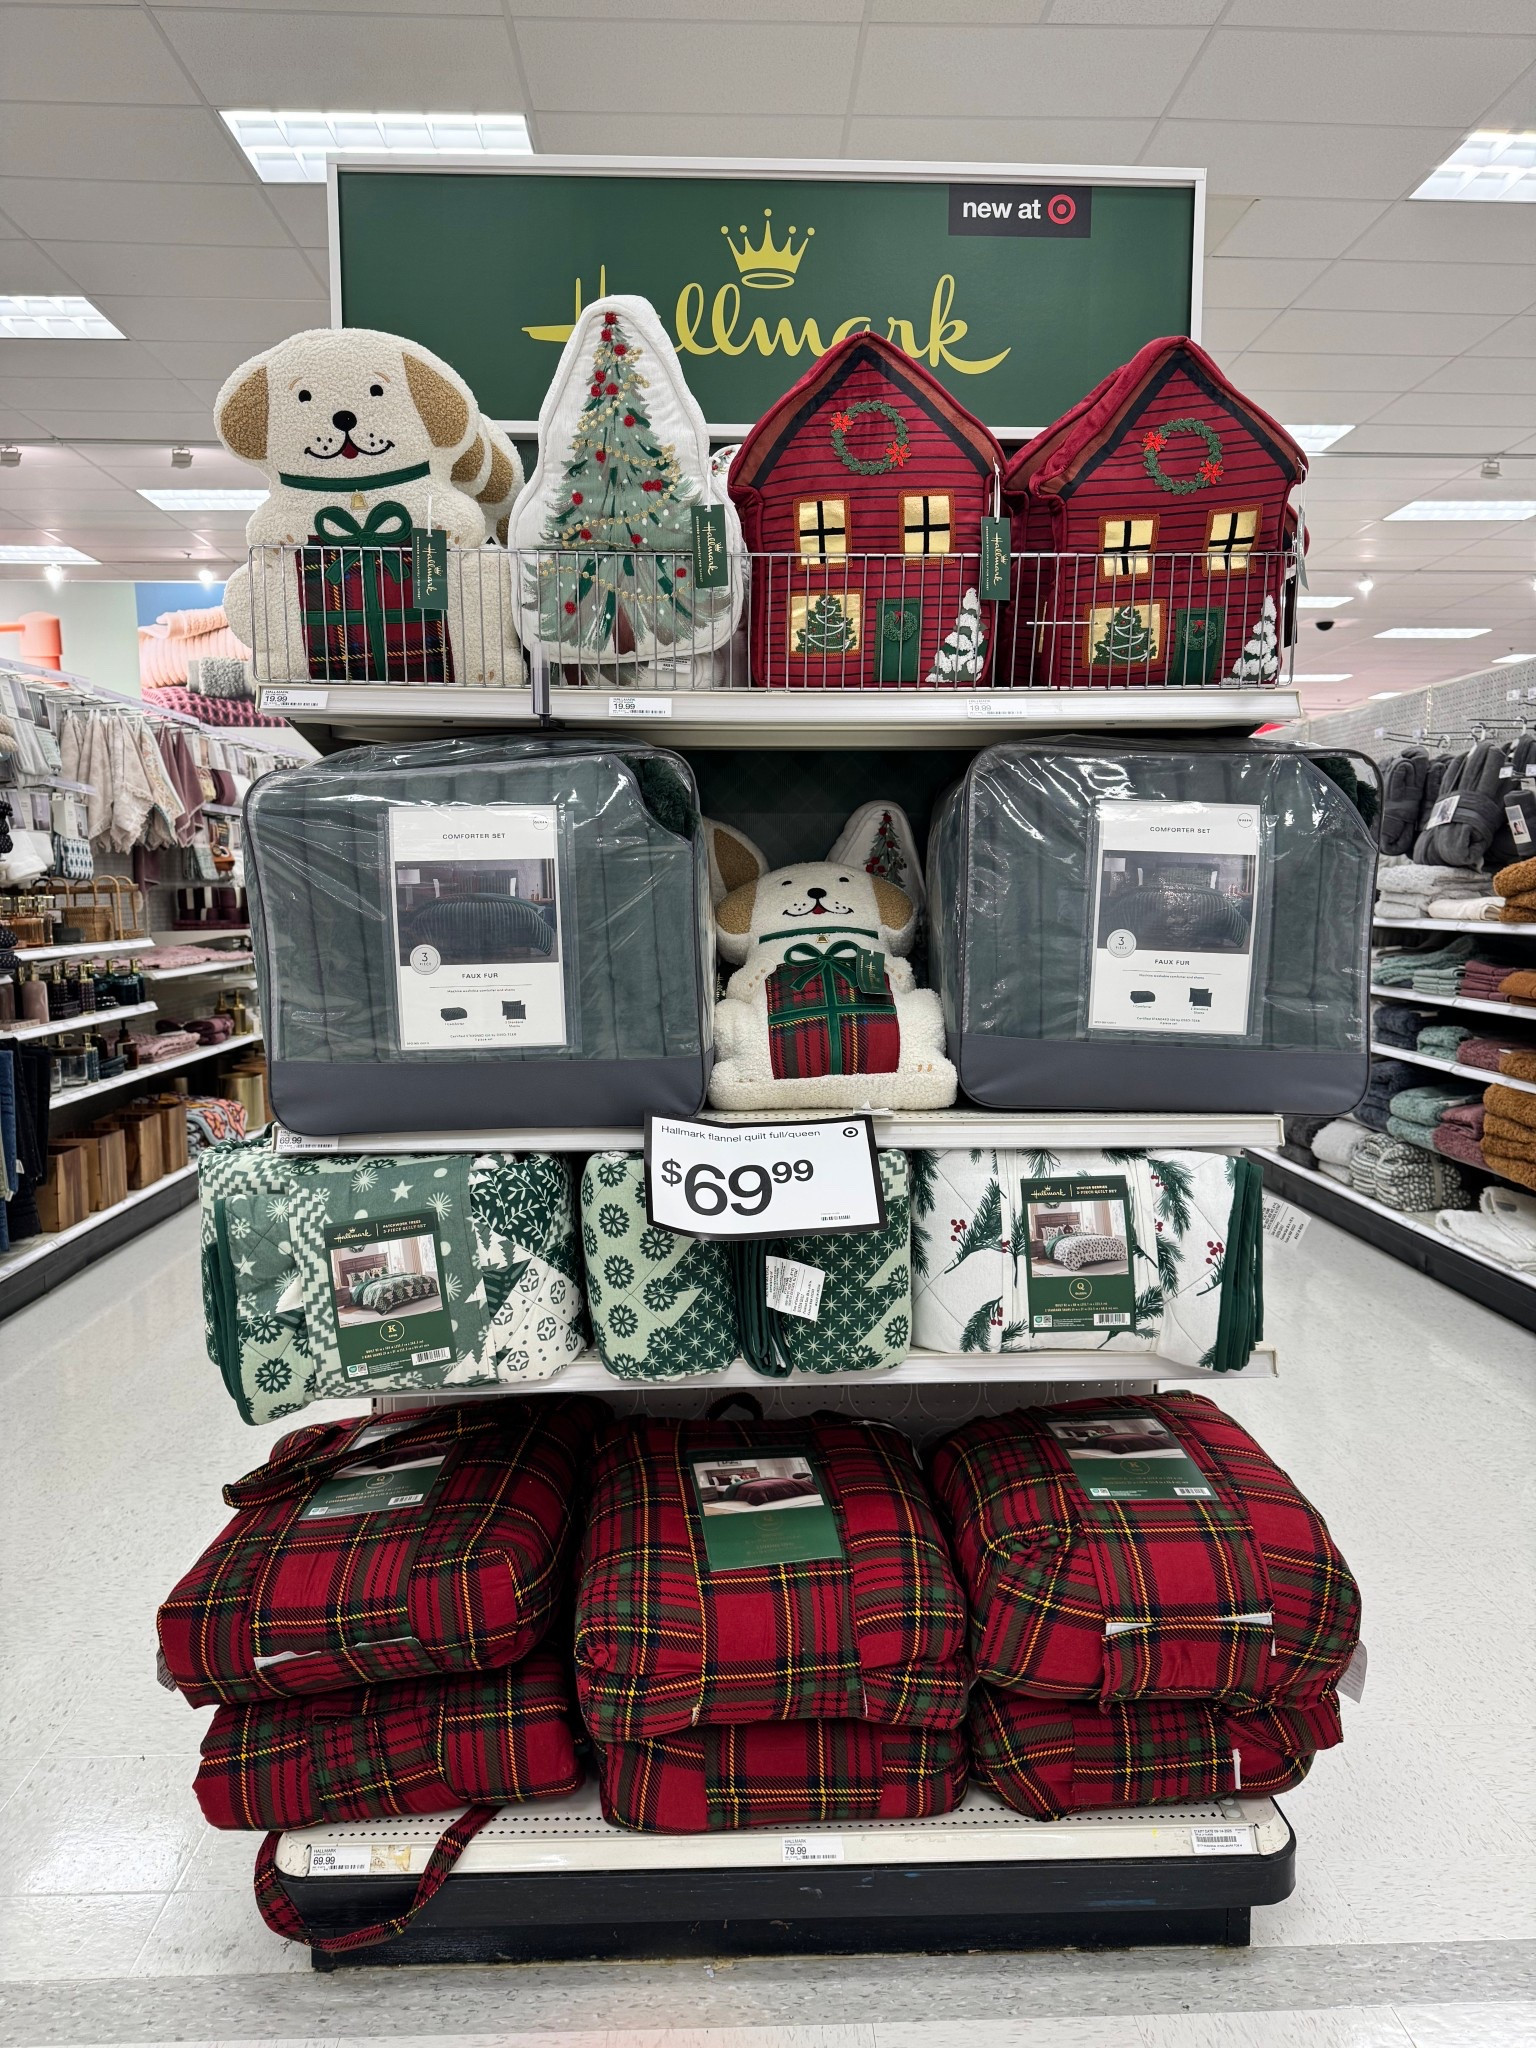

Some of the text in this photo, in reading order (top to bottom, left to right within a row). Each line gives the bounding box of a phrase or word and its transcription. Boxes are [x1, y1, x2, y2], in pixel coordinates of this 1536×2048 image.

[963, 199, 1041, 219] new at
[521, 264, 1012, 374] Hllmark
[702, 521, 718, 576] Hallmark
[991, 532, 1003, 586] Hallmark
[422, 543, 437, 596] Hallmark
[1149, 826, 1195, 834] COMFORTER
[442, 832, 490, 840] COMFORTER
[1118, 936, 1125, 946] 3
[421, 952, 428, 962] 3
[661, 1125, 821, 1143] Hallmark flannel quilt full/queen
[279, 1136, 302, 1144] 69.99
[1030, 1188, 1066, 1199] Hallmark
[333, 1228, 373, 1243] Hallmark
[1076, 1282, 1085, 1291] Q
[387, 1324, 397, 1333] K
[785, 1846, 807, 1855] 79.99
[313, 1856, 336, 1865] 69.99
